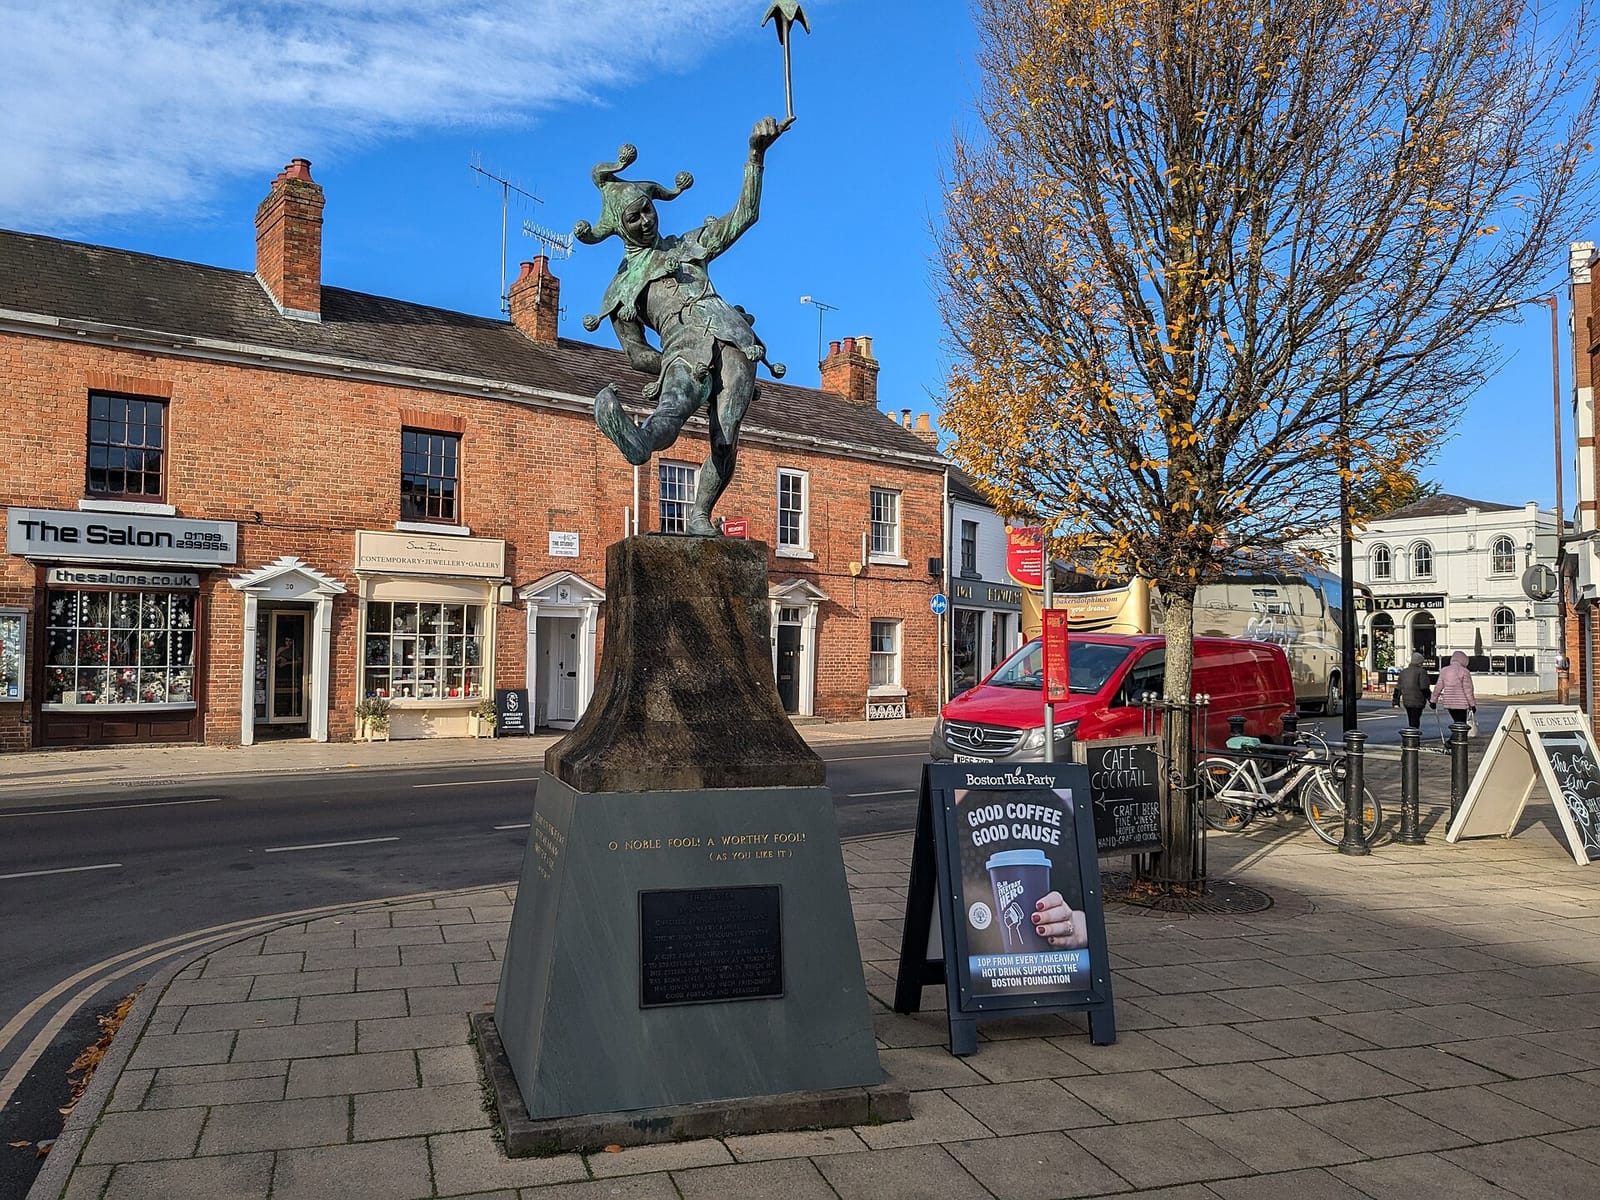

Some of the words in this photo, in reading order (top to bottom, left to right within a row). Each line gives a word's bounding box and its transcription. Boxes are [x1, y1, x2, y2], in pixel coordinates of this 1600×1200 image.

[18, 520, 79, 543] The
[87, 524, 173, 548] Salon
[184, 532, 222, 542] 01789
[176, 540, 229, 551] 299955
[56, 570, 193, 587] thesalons.co.uk
[1378, 599, 1404, 609] TAJ
[1533, 717, 1546, 727] HE
[1546, 717, 1563, 727] ONE
[1102, 745, 1139, 771] CAFÉ
[966, 773, 1005, 786] Boston
[1004, 773, 1026, 785] Tea
[1026, 773, 1056, 788] Party
[1091, 770, 1152, 790] COCKTAIL
[967, 804, 1004, 827] GOOD
[1006, 803, 1063, 827] COFFEE
[1112, 803, 1140, 818] CRAFT
[1142, 801, 1160, 815] BEER
[1115, 815, 1131, 828] FINE
[608, 841, 618, 851] O
[624, 839, 661, 851] NOBLE
[668, 837, 701, 848] FOOL!
[707, 838, 715, 846] A
[721, 834, 769, 846] WORTHY
[774, 833, 806, 843] FOOL!
[972, 824, 1009, 847] GOOD
[1011, 823, 1061, 846] CAUSE
[732, 851, 751, 860] YOU
[755, 850, 773, 859] LIKE
[1000, 885, 1024, 911] HERO
[977, 958, 991, 967] 10P
[993, 957, 1014, 966] FROM
[1015, 955, 1039, 965] EVERY
[1039, 953, 1080, 964] TAKEAWAY
[982, 968, 997, 978] HOT
[998, 967, 1021, 977] DRINK
[1023, 965, 1061, 975] SUPPORTS
[1062, 964, 1078, 973] THE
[991, 978, 1021, 988] BOSTON
[1022, 975, 1071, 986] FOUNDATION
